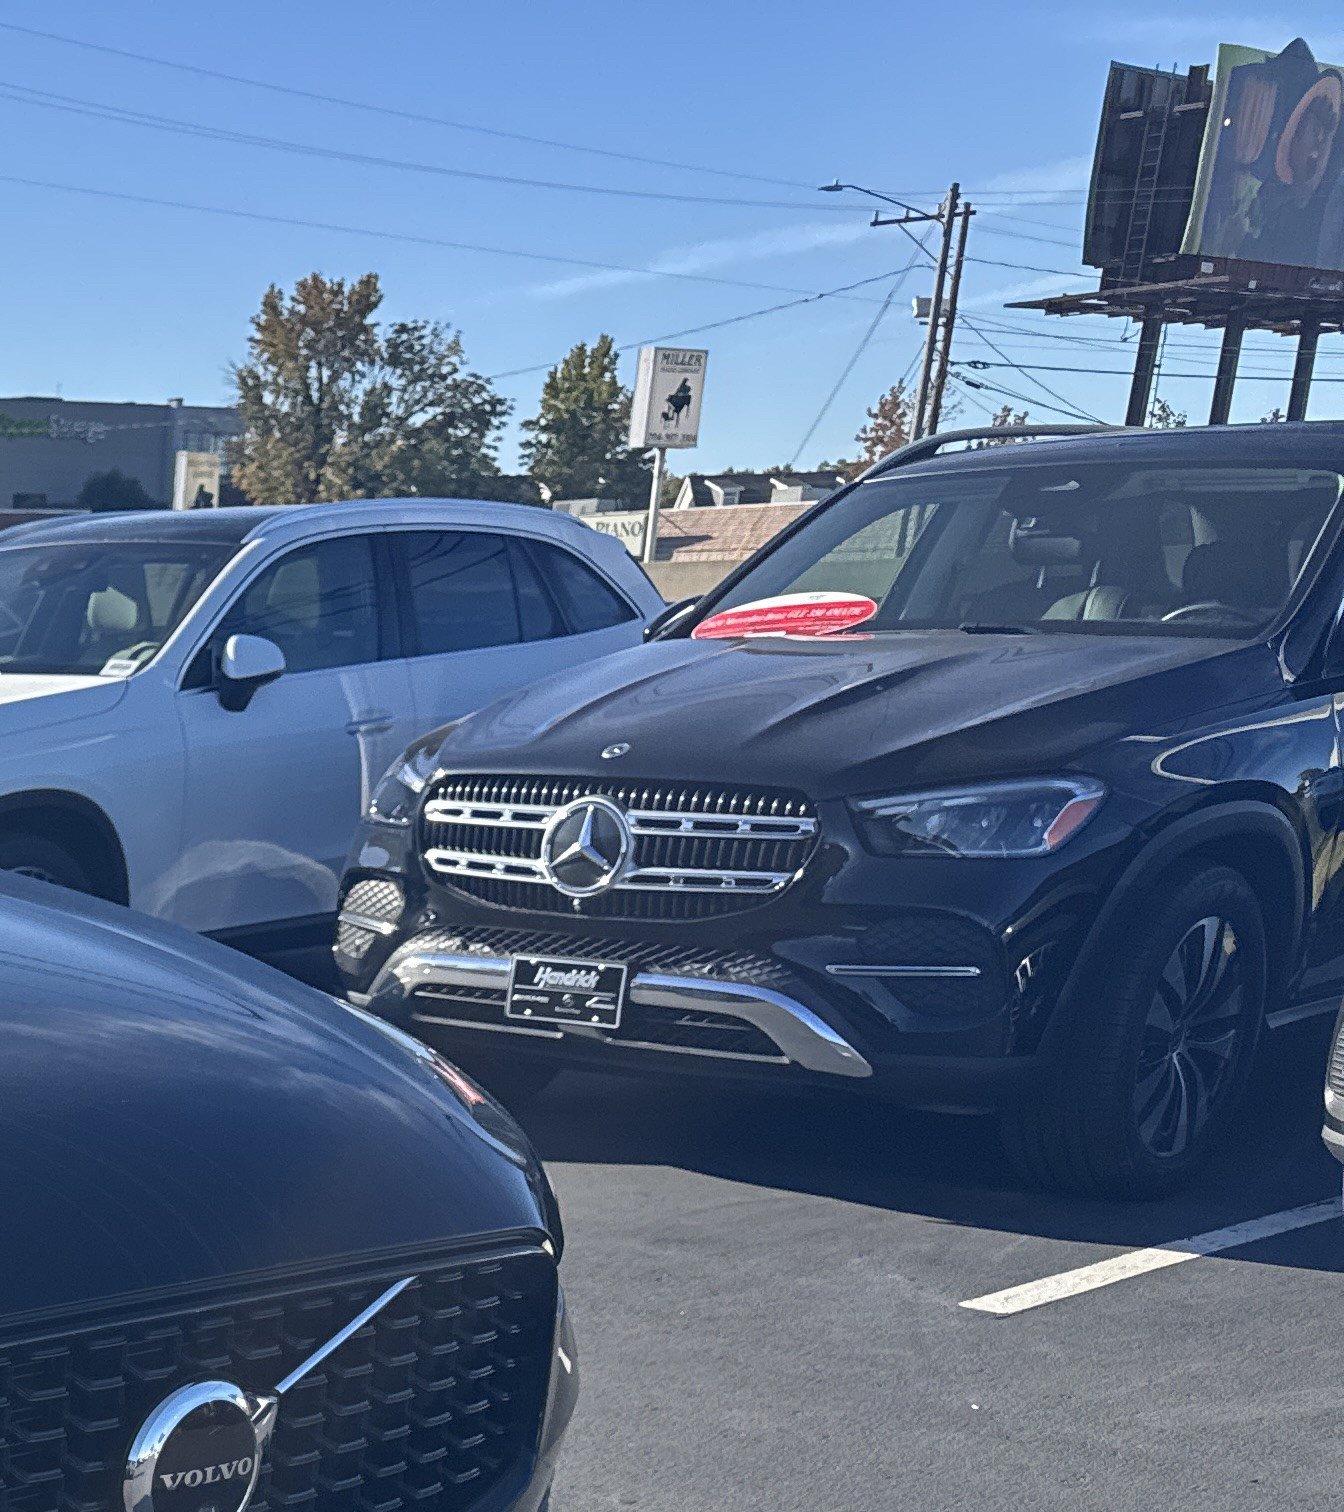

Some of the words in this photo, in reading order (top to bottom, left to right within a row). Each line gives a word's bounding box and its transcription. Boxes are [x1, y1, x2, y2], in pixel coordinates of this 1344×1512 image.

[661, 352, 702, 367] MILLER
[595, 521, 643, 537] PIANO
[160, 1457, 252, 1490] VOLVO
